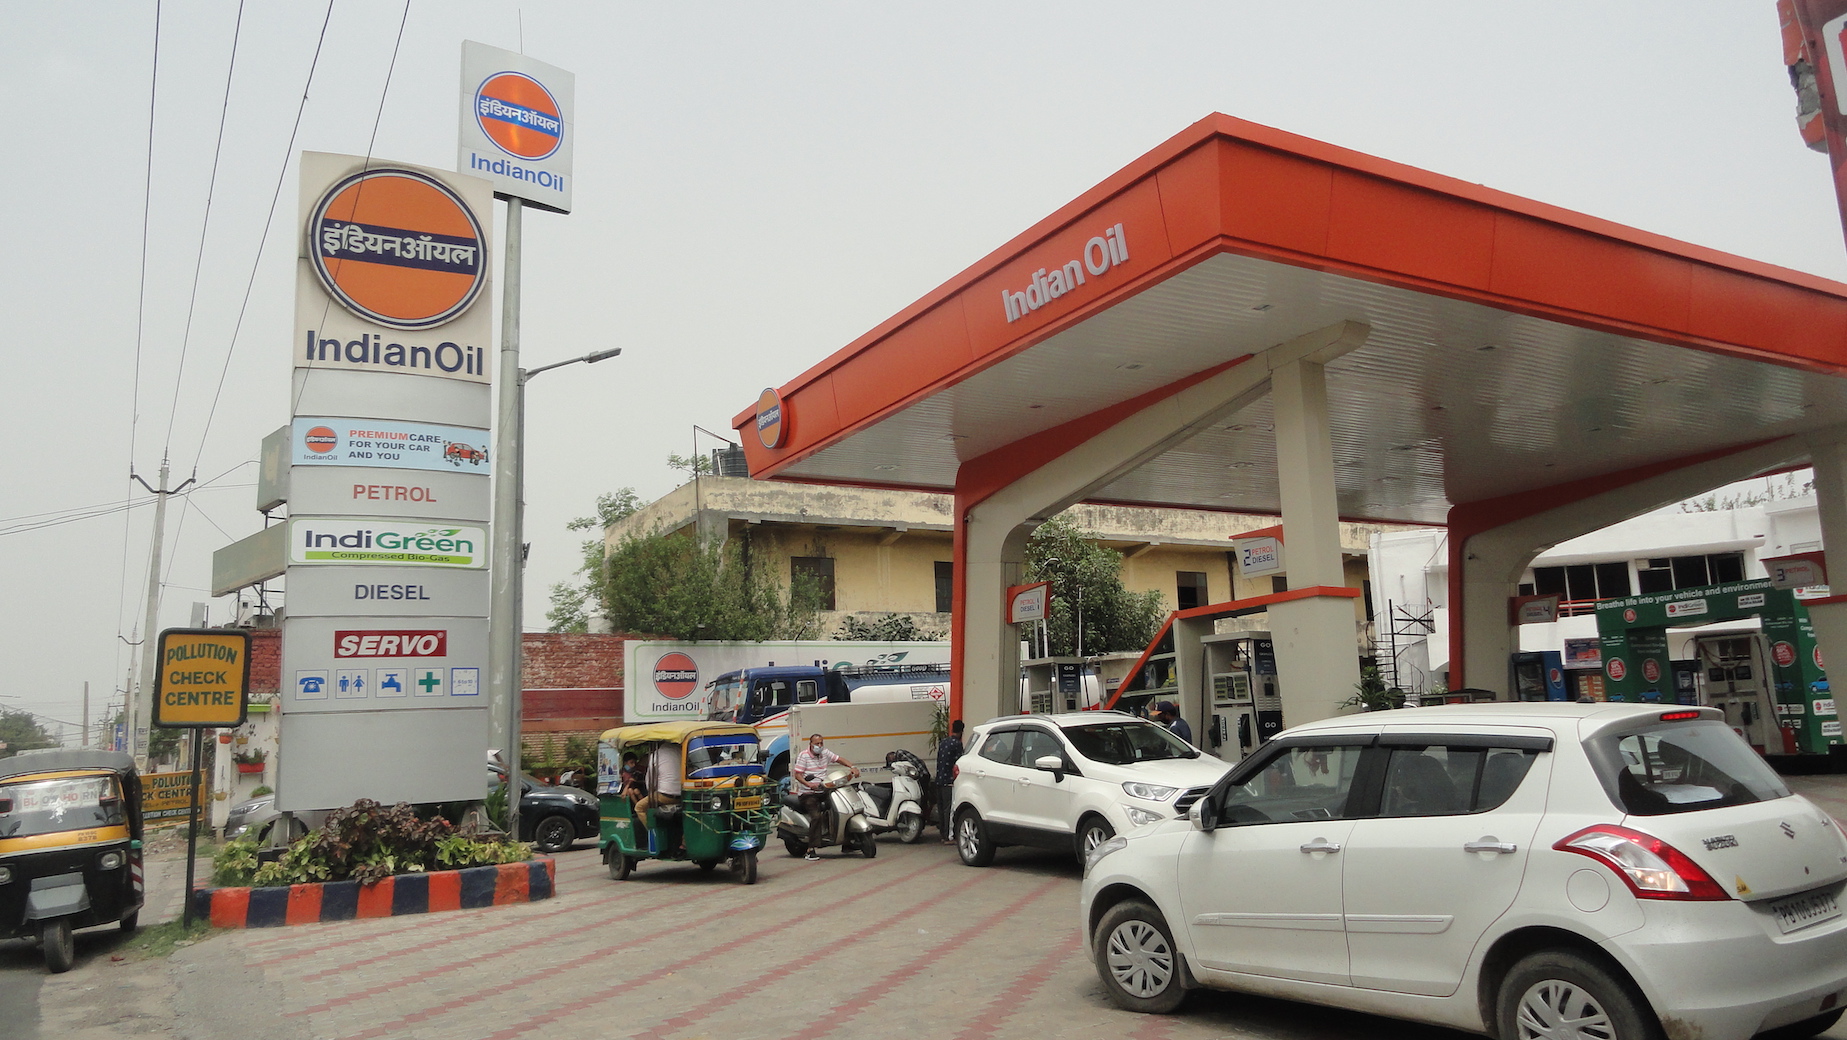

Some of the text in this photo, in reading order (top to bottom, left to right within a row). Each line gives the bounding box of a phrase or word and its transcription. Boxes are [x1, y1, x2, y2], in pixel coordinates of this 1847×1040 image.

[480, 97, 560, 134] इंडियनऑयल
[470, 152, 564, 193] IndianOil
[322, 223, 477, 266] इंडियनऑयल
[1001, 222, 1129, 323] Indian Oil
[306, 330, 484, 376] IndianOil
[349, 429, 442, 444] PREMIUMCARE
[349, 440, 431, 452] FOR YOUR CAR
[348, 451, 400, 460] AND YOU
[353, 484, 437, 503] PETROL
[331, 551, 450, 562] Compressed Bio-Gas
[1243, 545, 1274, 567] 2 PETROL
[1252, 553, 1275, 564] DIESEL
[1776, 568, 1786, 582] 3
[355, 584, 430, 600] DIESEL
[1596, 600, 1625, 610] Breathe
[1625, 597, 1638, 606] life
[1638, 596, 1654, 604] into
[1655, 594, 1673, 604] your
[1674, 588, 1703, 600] vehicle
[1705, 586, 1721, 596] and
[337, 634, 440, 656] SERVO
[166, 642, 238, 666] POLLUTION
[169, 670, 227, 685] CHECK
[165, 690, 235, 706] CENTRE
[652, 701, 700, 712] IndianOil
[1264, 721, 1277, 729] GO
[158, 788, 193, 799] CENTR
[1705, 840, 1739, 851] SUZUKI
